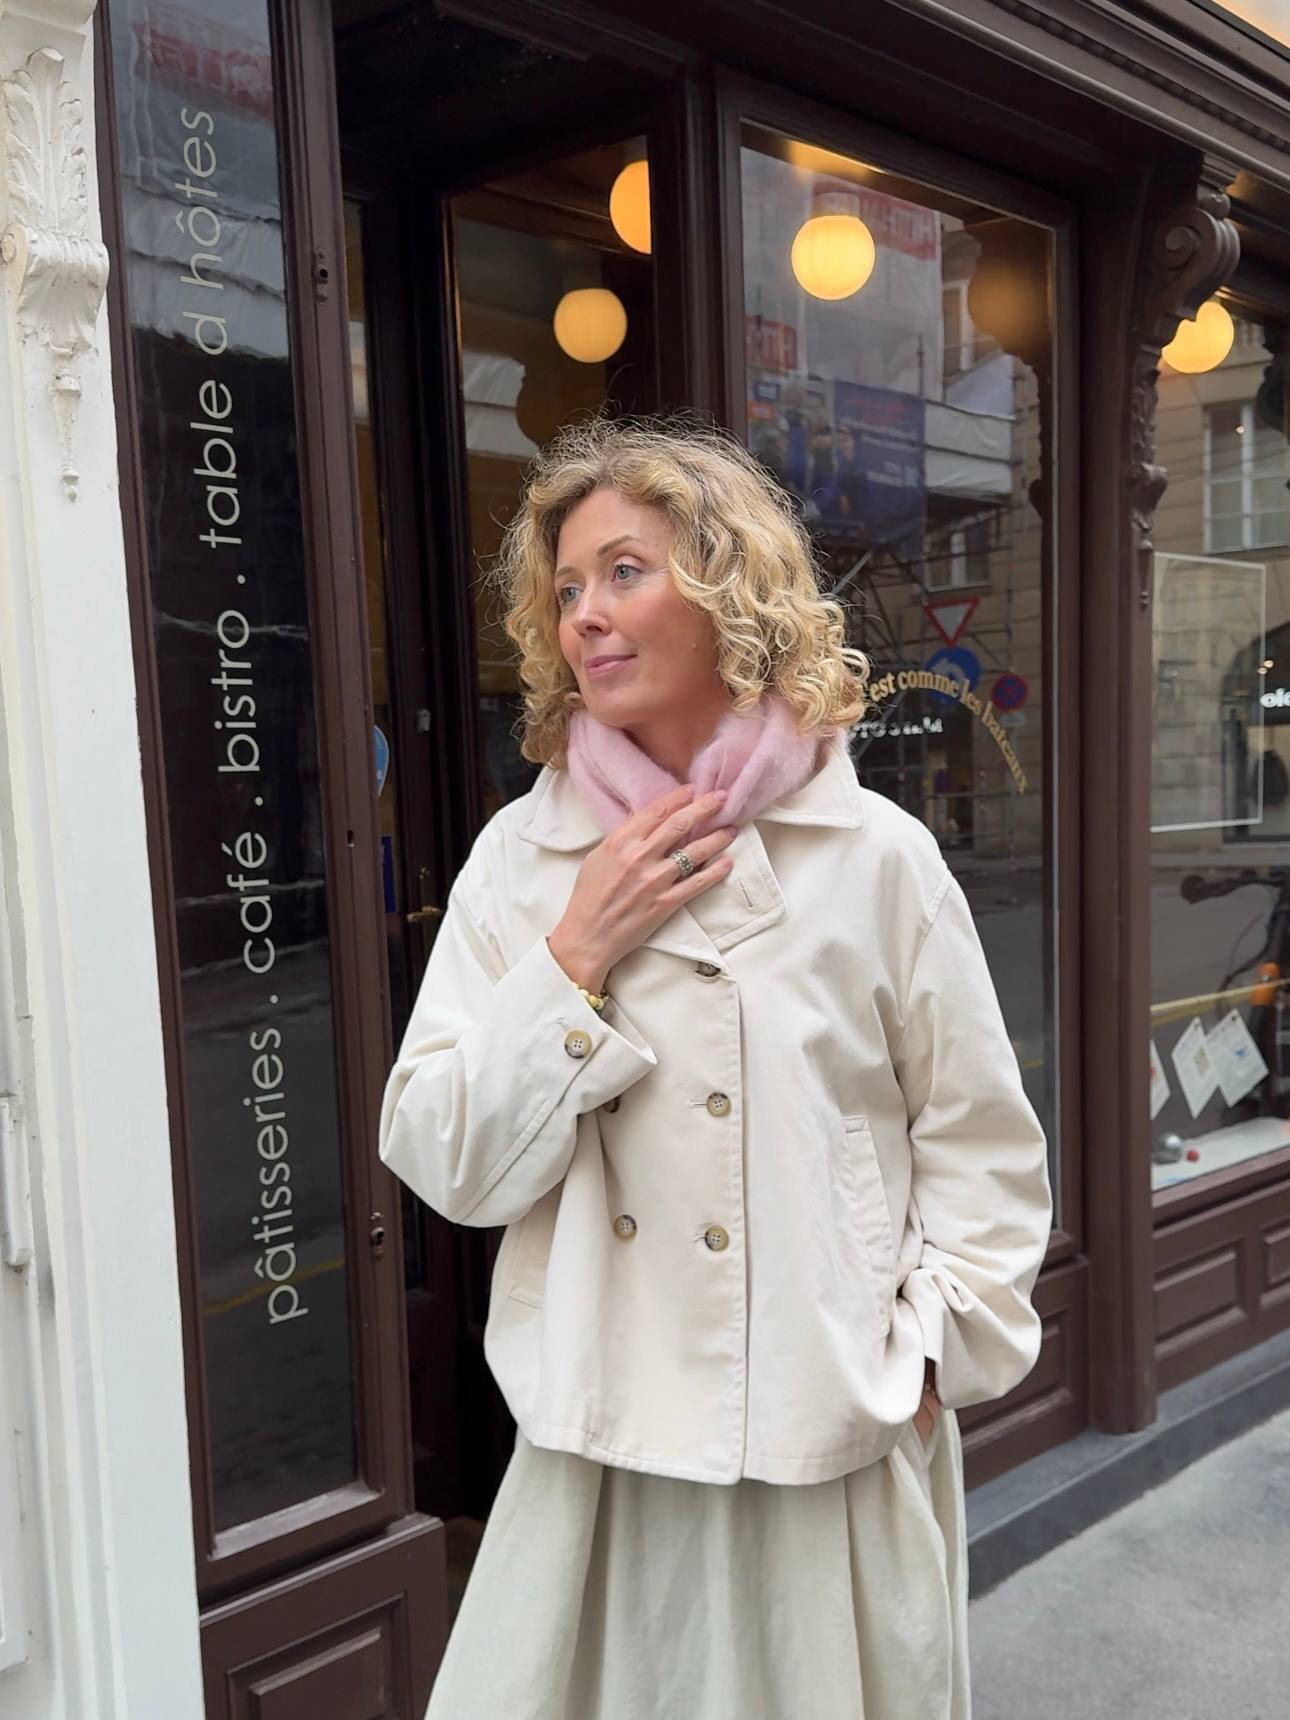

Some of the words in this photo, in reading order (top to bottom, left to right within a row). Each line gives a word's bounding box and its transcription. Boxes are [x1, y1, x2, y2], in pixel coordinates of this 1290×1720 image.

[174, 107, 224, 290] hôtes
[190, 379, 243, 550] table
[210, 609, 261, 774] bistro
[897, 670, 960, 698] comme
[960, 679, 983, 715] les
[220, 831, 277, 974] café
[242, 1028, 309, 1325] pâtisseries
